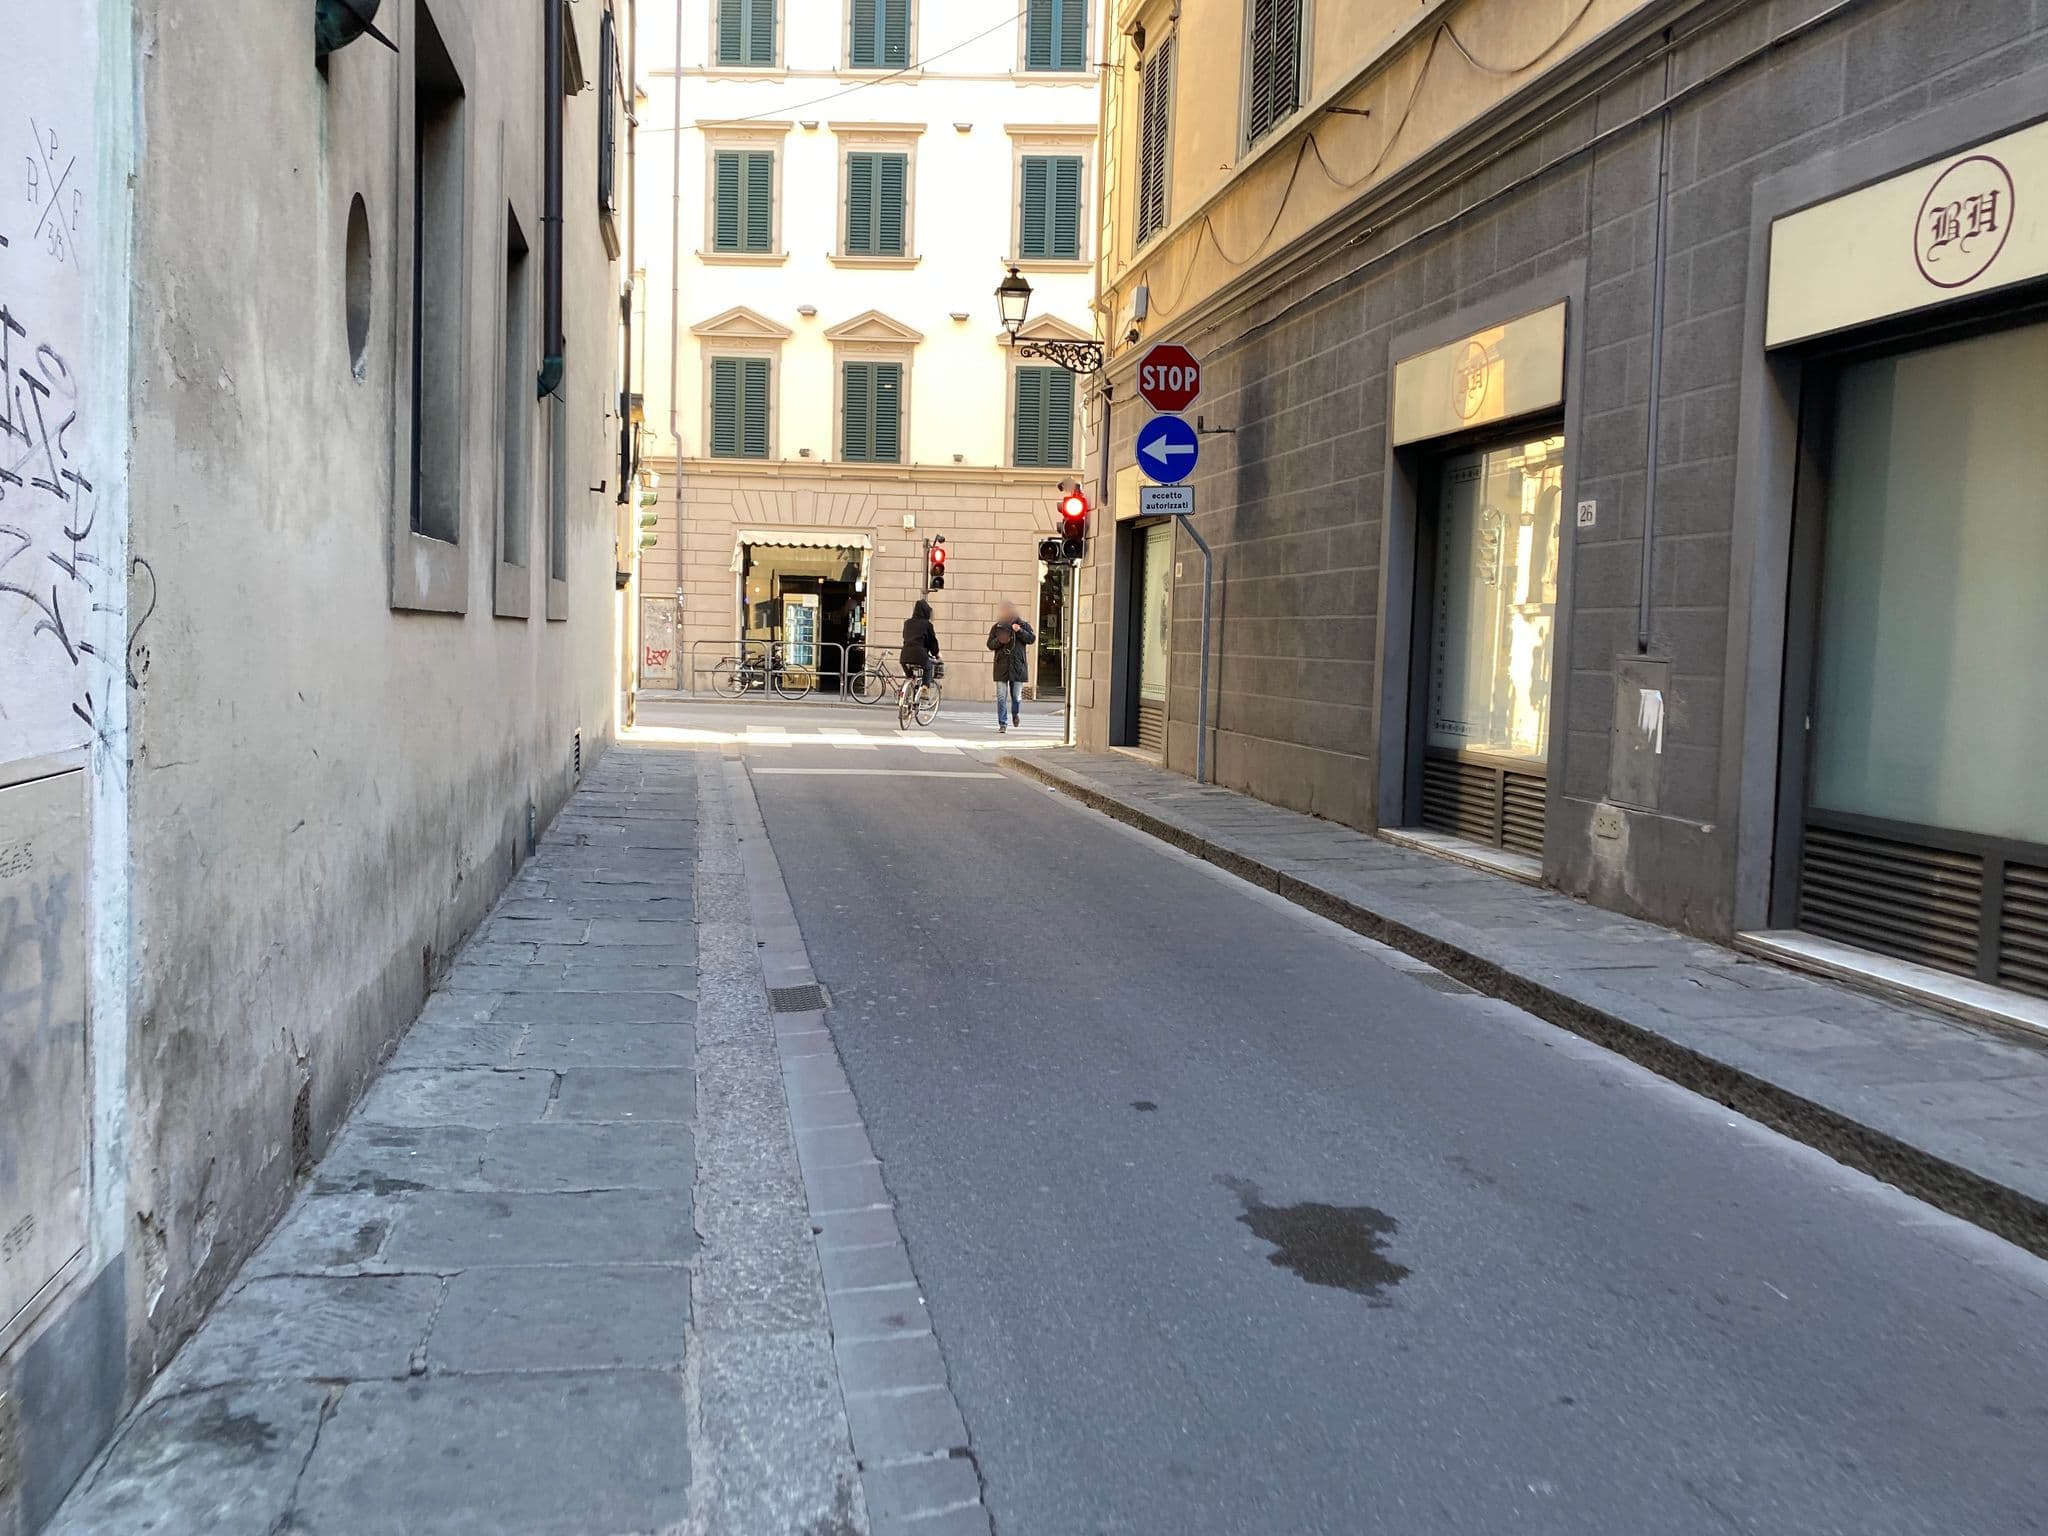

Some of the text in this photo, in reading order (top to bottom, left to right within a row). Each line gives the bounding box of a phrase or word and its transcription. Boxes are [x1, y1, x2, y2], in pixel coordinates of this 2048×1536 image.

[1143, 365, 1197, 392] STOP
[1152, 492, 1183, 500] eccetto
[1146, 501, 1188, 510] autorizzati
[1580, 504, 1593, 522] 26
